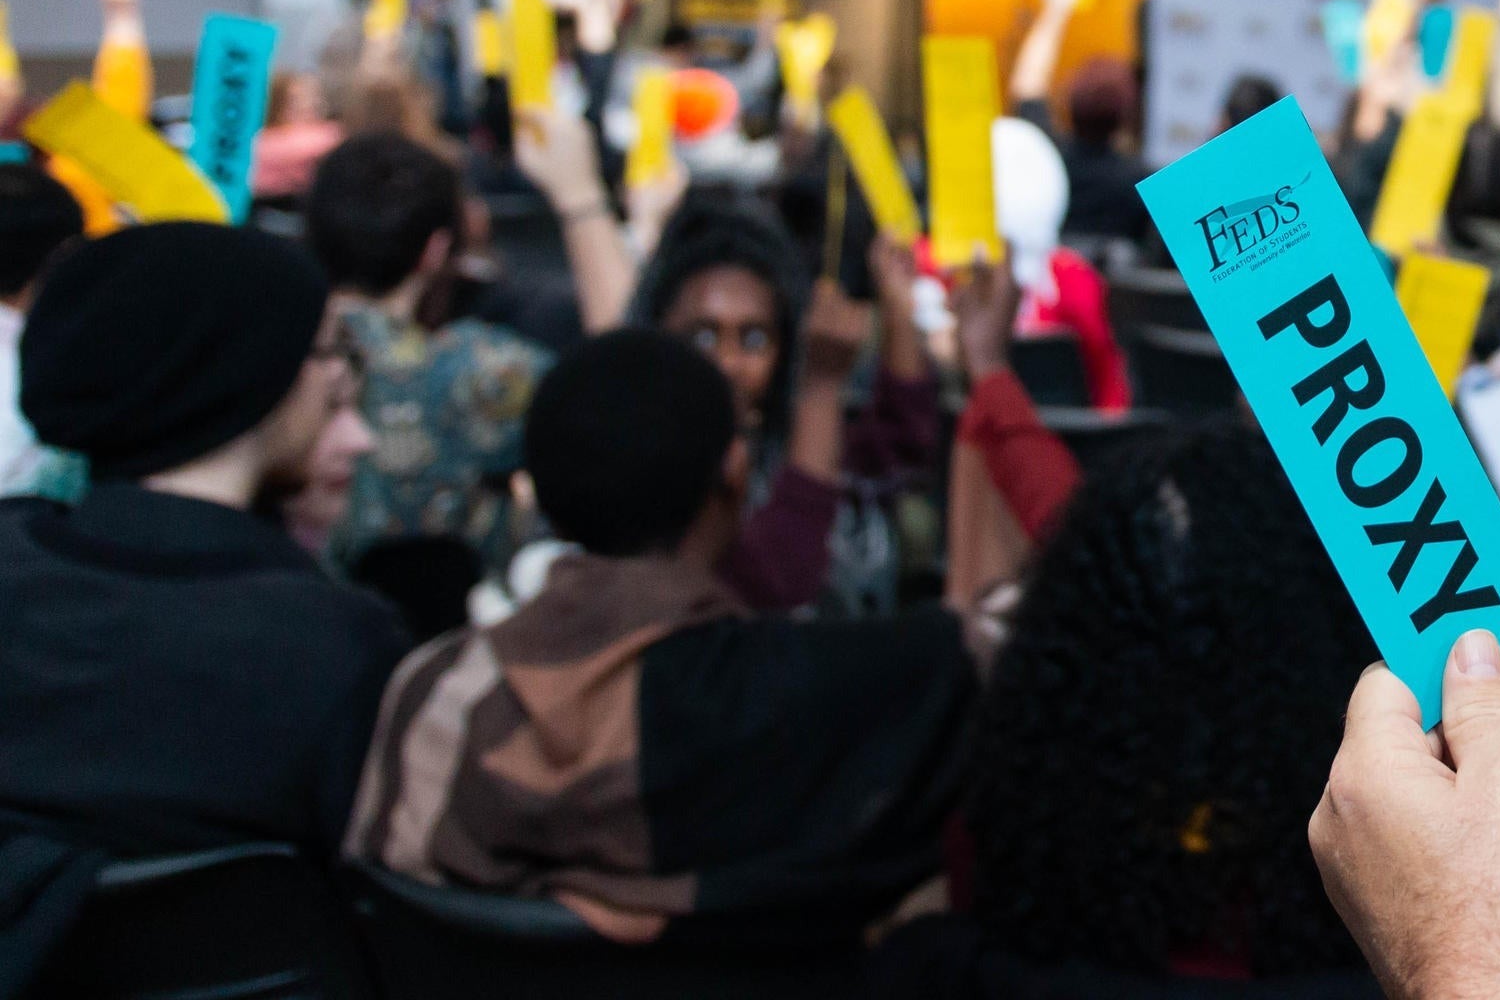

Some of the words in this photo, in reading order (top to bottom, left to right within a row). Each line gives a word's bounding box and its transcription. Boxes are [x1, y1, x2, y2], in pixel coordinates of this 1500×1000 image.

[1193, 185, 1300, 273] FEDS
[1211, 252, 1257, 284] FEDERATION
[1258, 245, 1268, 256] OF
[1269, 221, 1308, 249] STUDENTS
[1249, 249, 1278, 272] University
[1285, 230, 1311, 250] Waterloo
